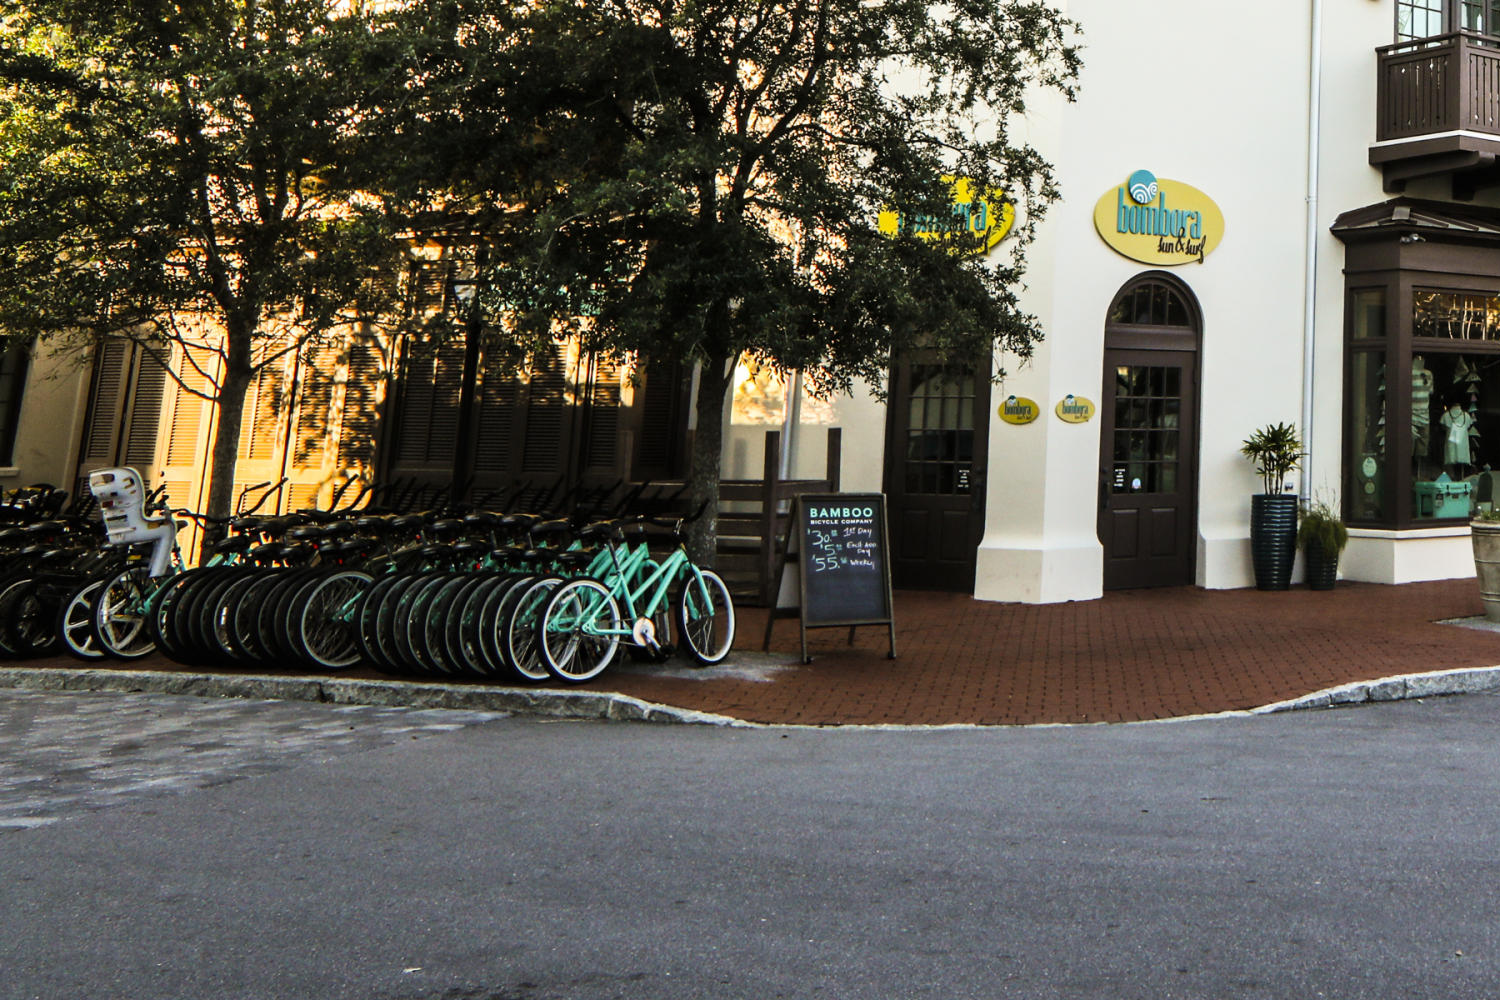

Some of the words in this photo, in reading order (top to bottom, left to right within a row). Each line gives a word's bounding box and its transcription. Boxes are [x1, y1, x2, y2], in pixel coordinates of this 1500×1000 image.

[1116, 187, 1202, 240] bombora
[1157, 236, 1174, 254] sun
[1175, 226, 1185, 253] &
[1185, 235, 1207, 264] surf
[809, 507, 873, 518] BAMBOO
